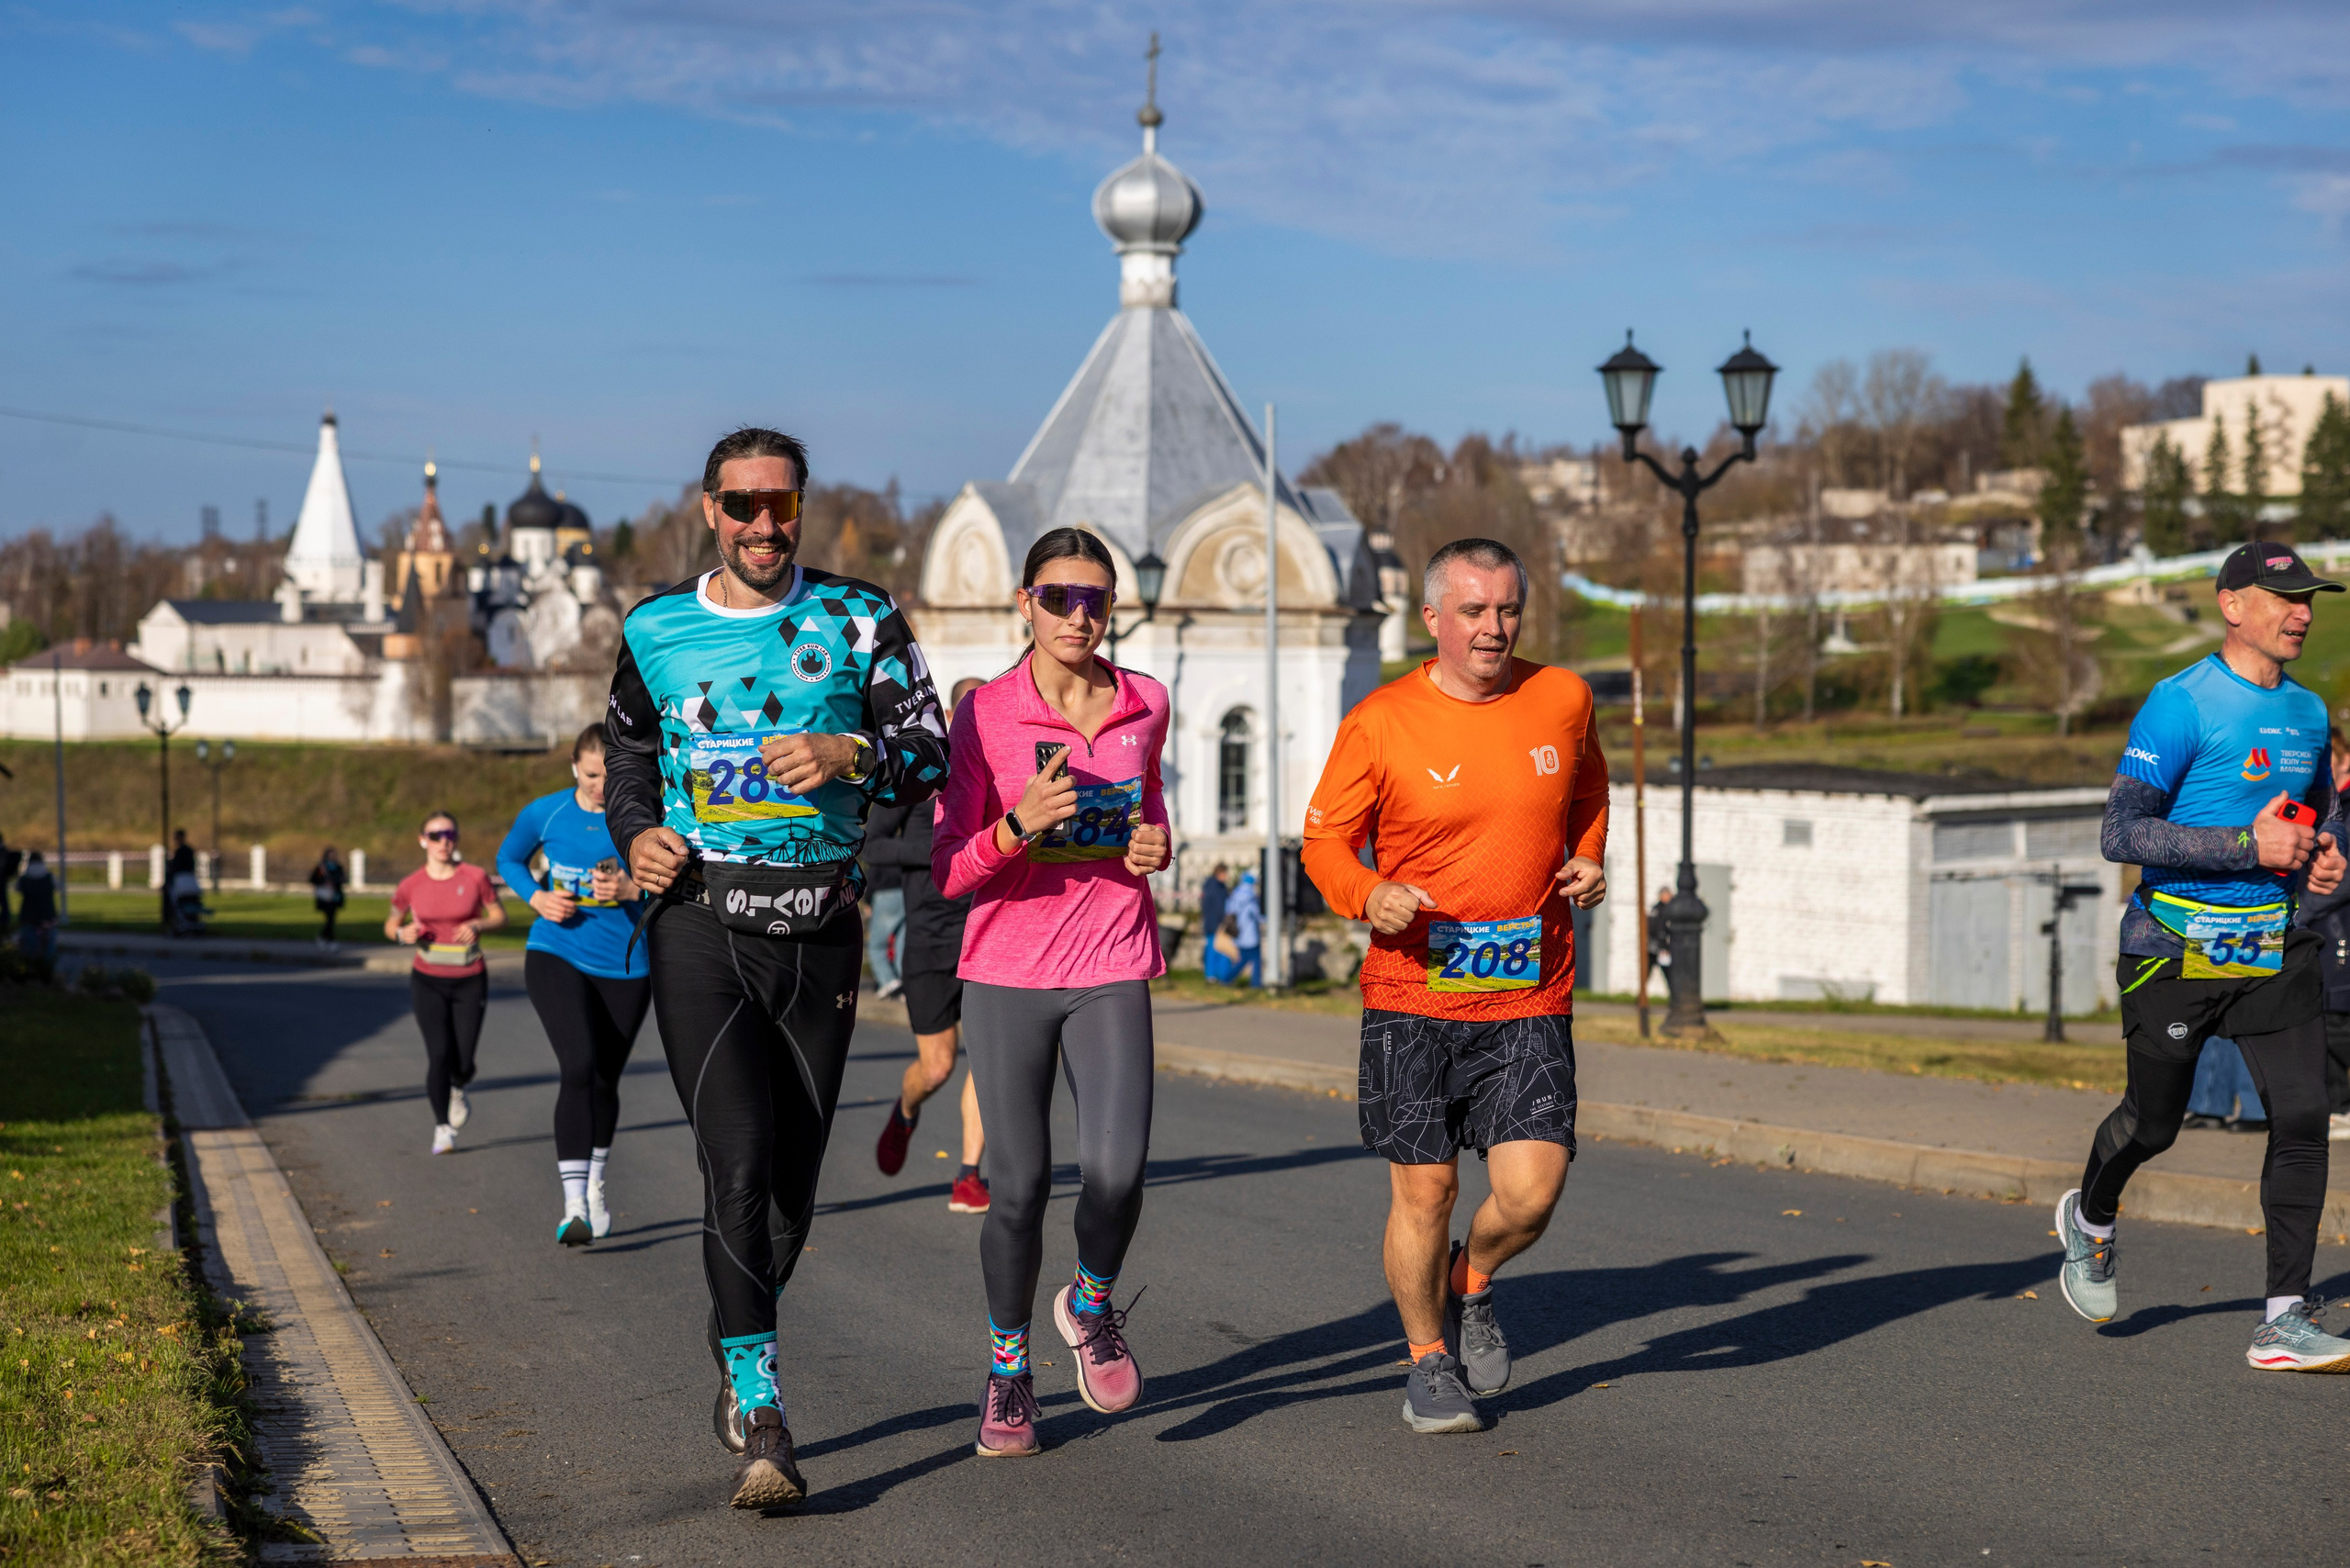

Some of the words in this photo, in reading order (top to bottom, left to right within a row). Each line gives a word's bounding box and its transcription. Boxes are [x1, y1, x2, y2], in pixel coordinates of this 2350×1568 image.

[794, 645, 806, 656] TVER
[819, 647, 828, 656] LAB
[894, 690, 925, 714] TVER
[617, 705, 632, 726] LAB
[698, 737, 755, 749] СТАРИЦКИЕ
[1528, 745, 1560, 777] 10
[2131, 747, 2160, 766] DKC
[2280, 749, 2312, 758] ТВЕРСКОЙ
[2280, 766, 2313, 774] МАРАФОН
[707, 756, 801, 805] 28
[1101, 783, 1136, 796] ВЕРСТЫ
[2194, 916, 2242, 924] СТАРИЦКИЕ
[2246, 914, 2280, 924] ВЕРСТЫ
[1437, 925, 1490, 935] СТАРИЦКИЕ
[1496, 921, 1535, 932] ВЕРСТЫ
[2209, 931, 2264, 967] 55
[1438, 937, 1531, 979] 208
